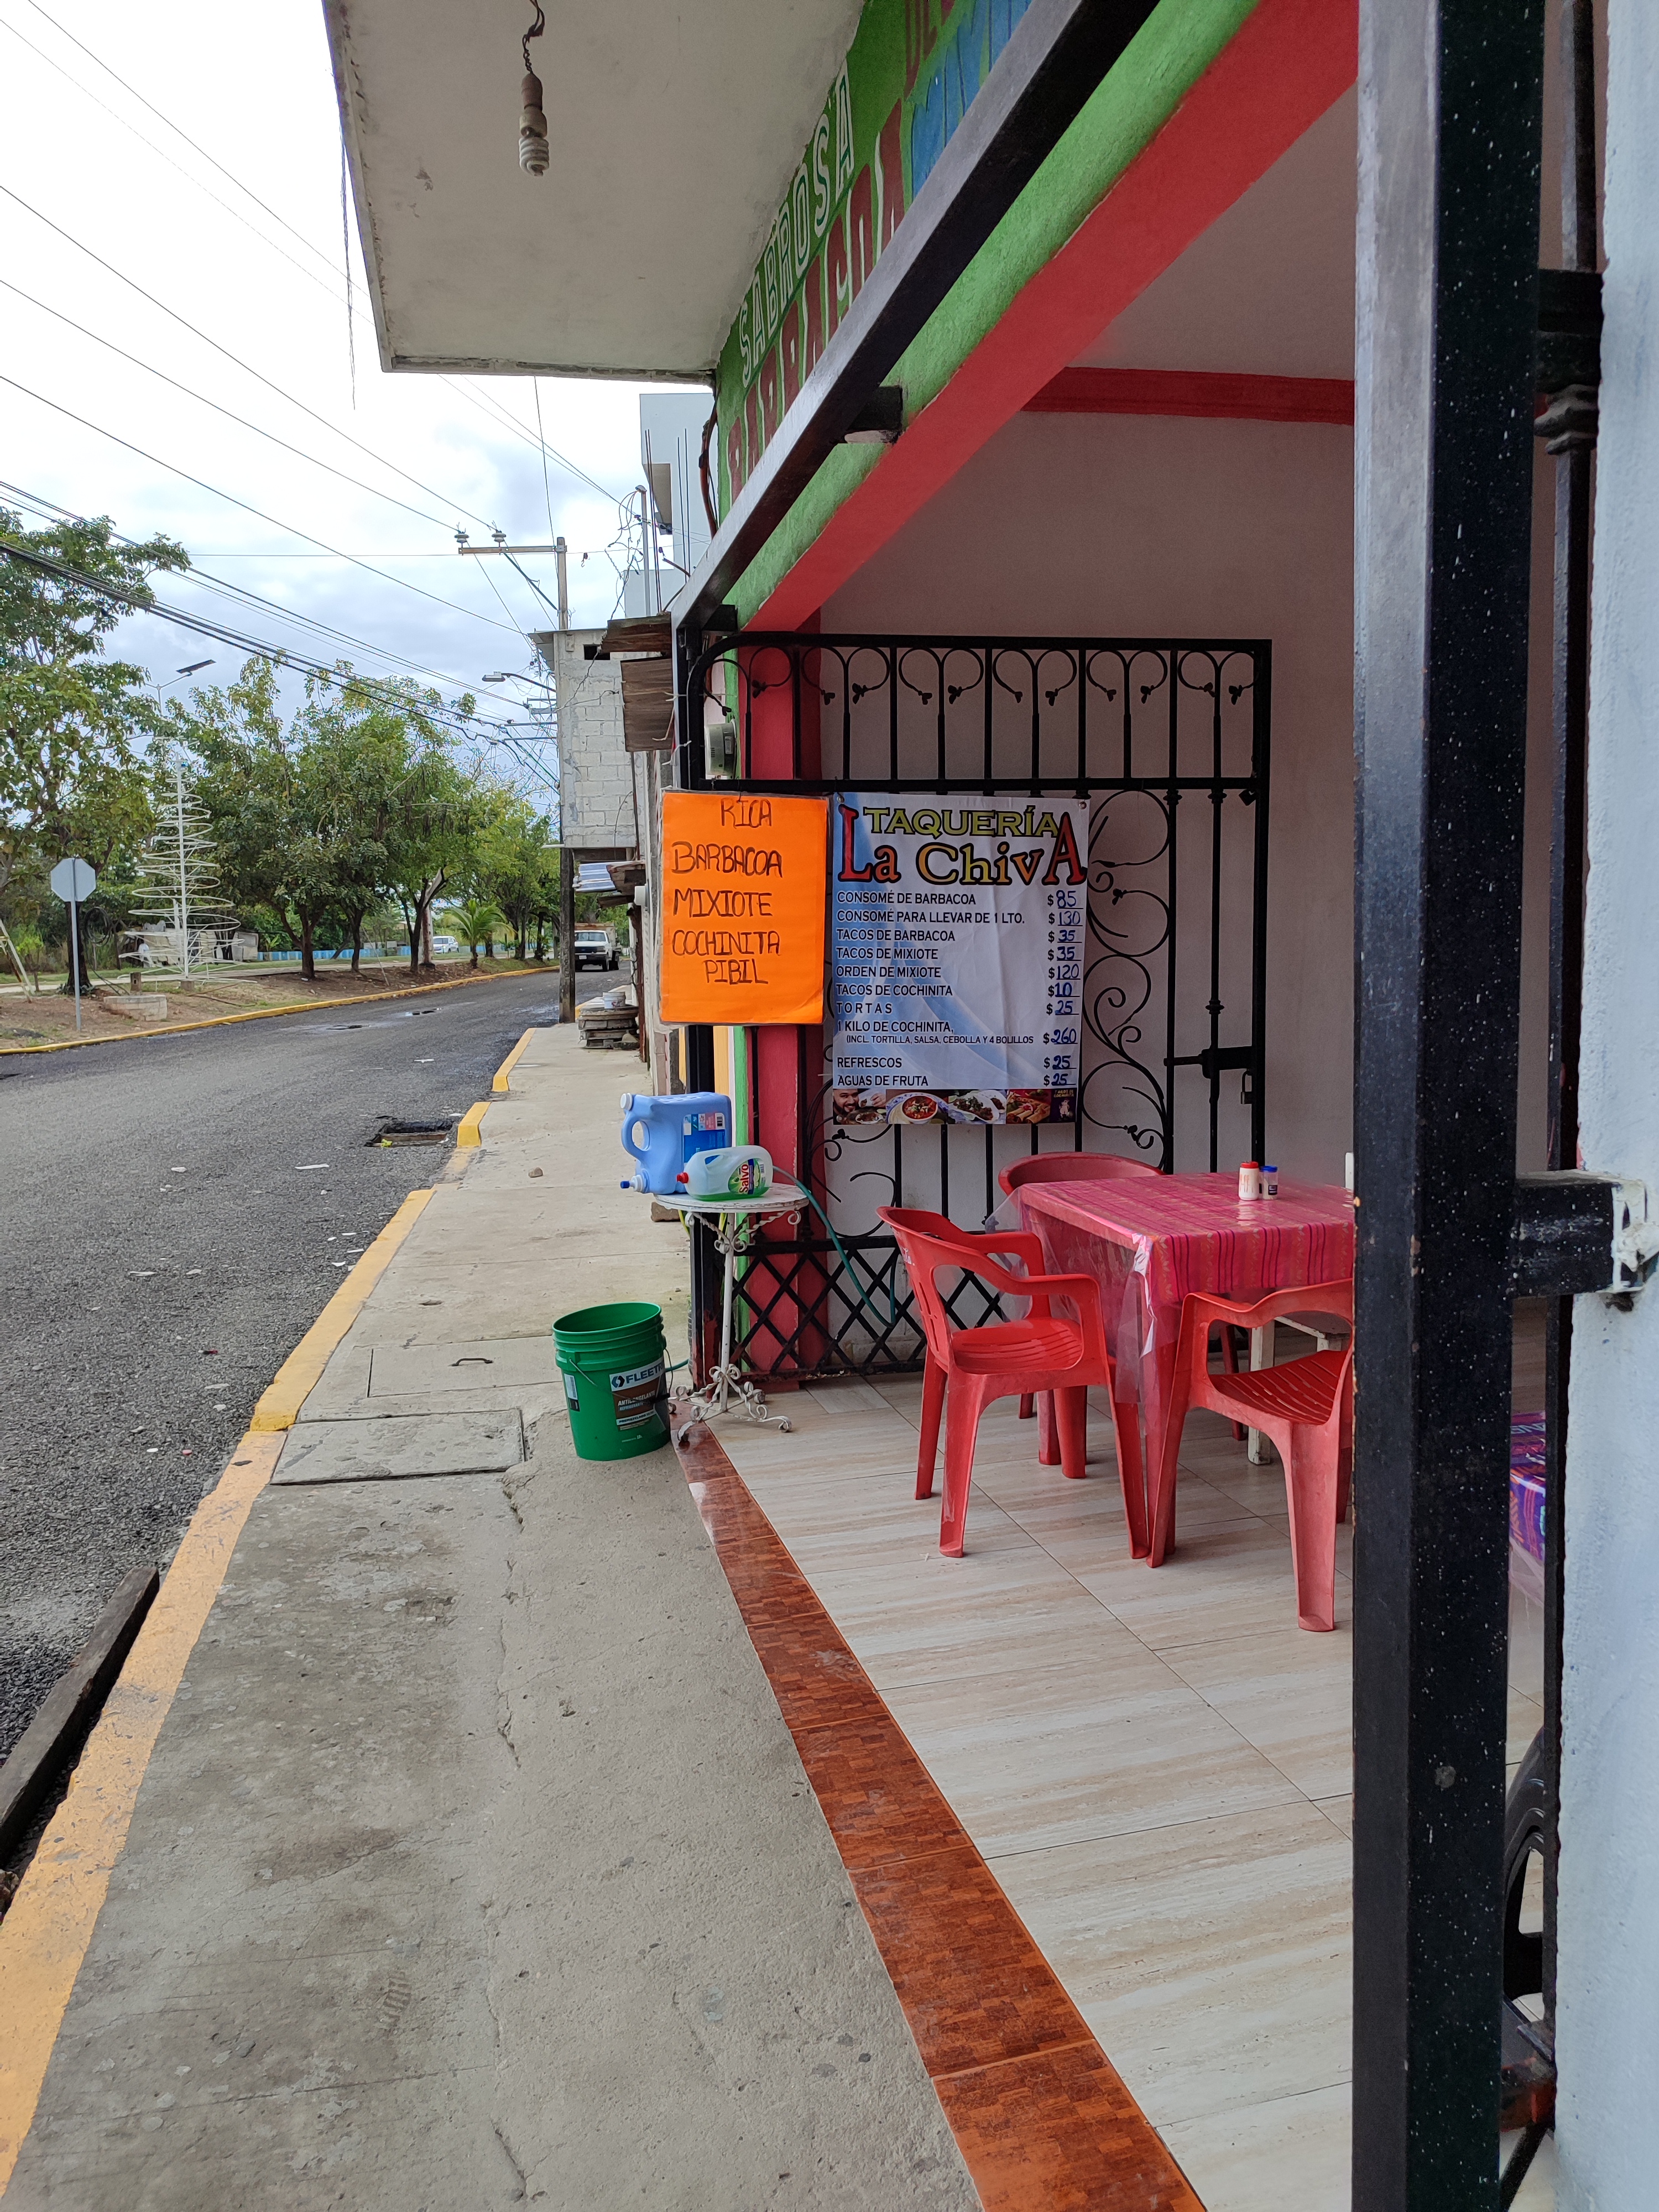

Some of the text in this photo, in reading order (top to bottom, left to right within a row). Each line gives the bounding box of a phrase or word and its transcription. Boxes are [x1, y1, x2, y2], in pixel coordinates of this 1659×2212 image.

[739, 58, 854, 388] SABROSA
[721, 798, 772, 828] RICA
[863, 805, 1060, 839] TAQUERÍA
[838, 804, 1087, 885] La ChivA
[671, 841, 782, 878] BARBACOA
[673, 888, 773, 918] MIXIOTE
[837, 890, 894, 904] CONSOMÉ
[898, 893, 912, 904] DE
[915, 894, 976, 904] BARBACOA
[837, 909, 894, 922] CONSOMÉ
[897, 912, 926, 922] PARA
[930, 912, 972, 923] LLEVAR
[975, 912, 990, 923] DE
[994, 913, 998, 923] 1
[1002, 913, 1025, 924] LTO.
[672, 930, 780, 956] COCHINITA
[837, 929, 874, 940] TACOS
[877, 930, 891, 940] DE
[894, 930, 956, 941] BARBACOA
[837, 948, 873, 958] TACOS
[877, 948, 891, 959] DE
[894, 948, 938, 959] MIXIOTE
[703, 958, 768, 985] PIBIL
[836, 966, 876, 977] ORDEN
[879, 967, 894, 977] DE
[897, 967, 941, 978] MIXIOTE
[837, 984, 872, 995] TACOS
[875, 985, 890, 995] DE
[893, 985, 953, 996] COCHINITA
[838, 1021, 954, 1034] 1 KILO DE COCHINITA,
[837, 1057, 902, 1068] REFRESCOS
[837, 1075, 872, 1086] AGUAS
[875, 1076, 890, 1086] DE
[893, 1076, 928, 1086] FRUTA
[739, 1164, 749, 1193] Salvo
